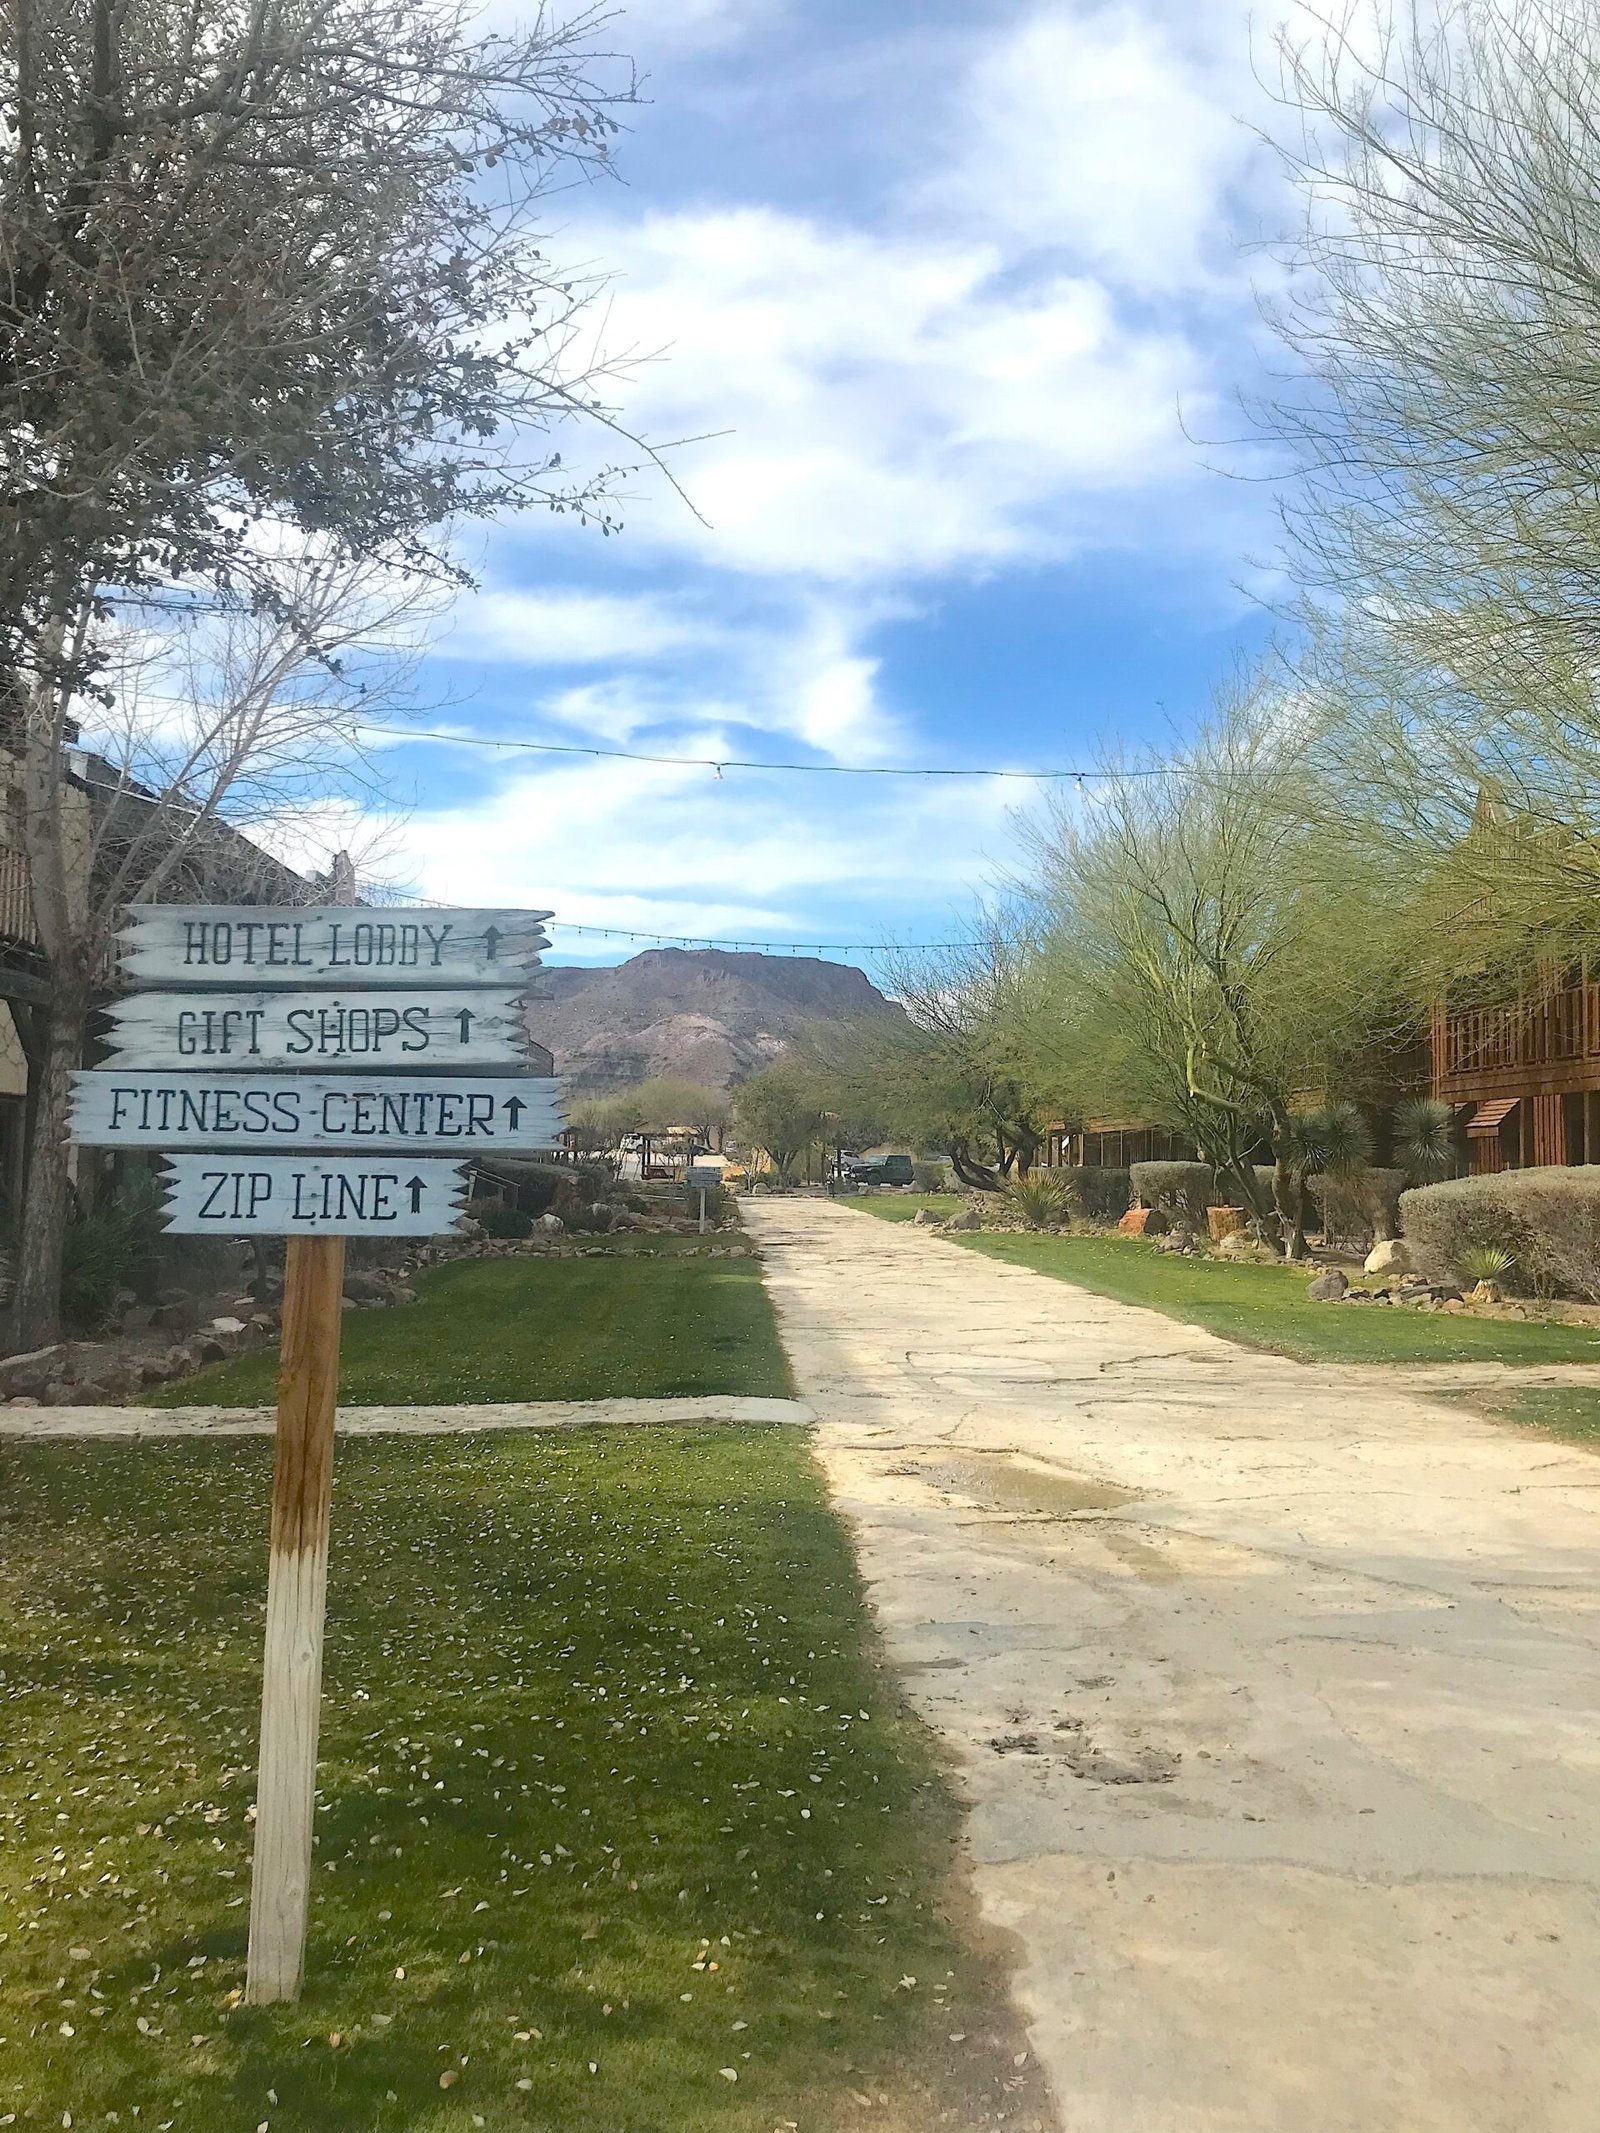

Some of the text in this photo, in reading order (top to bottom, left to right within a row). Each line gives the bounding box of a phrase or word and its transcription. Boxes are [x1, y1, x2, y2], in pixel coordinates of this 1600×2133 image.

[183, 921, 453, 967] HOTEL LOBBY
[178, 1006, 431, 1055] GIFT SHOPS
[108, 1088, 495, 1137] FITNESS CENTER
[198, 1172, 398, 1220] ZIP LINE
